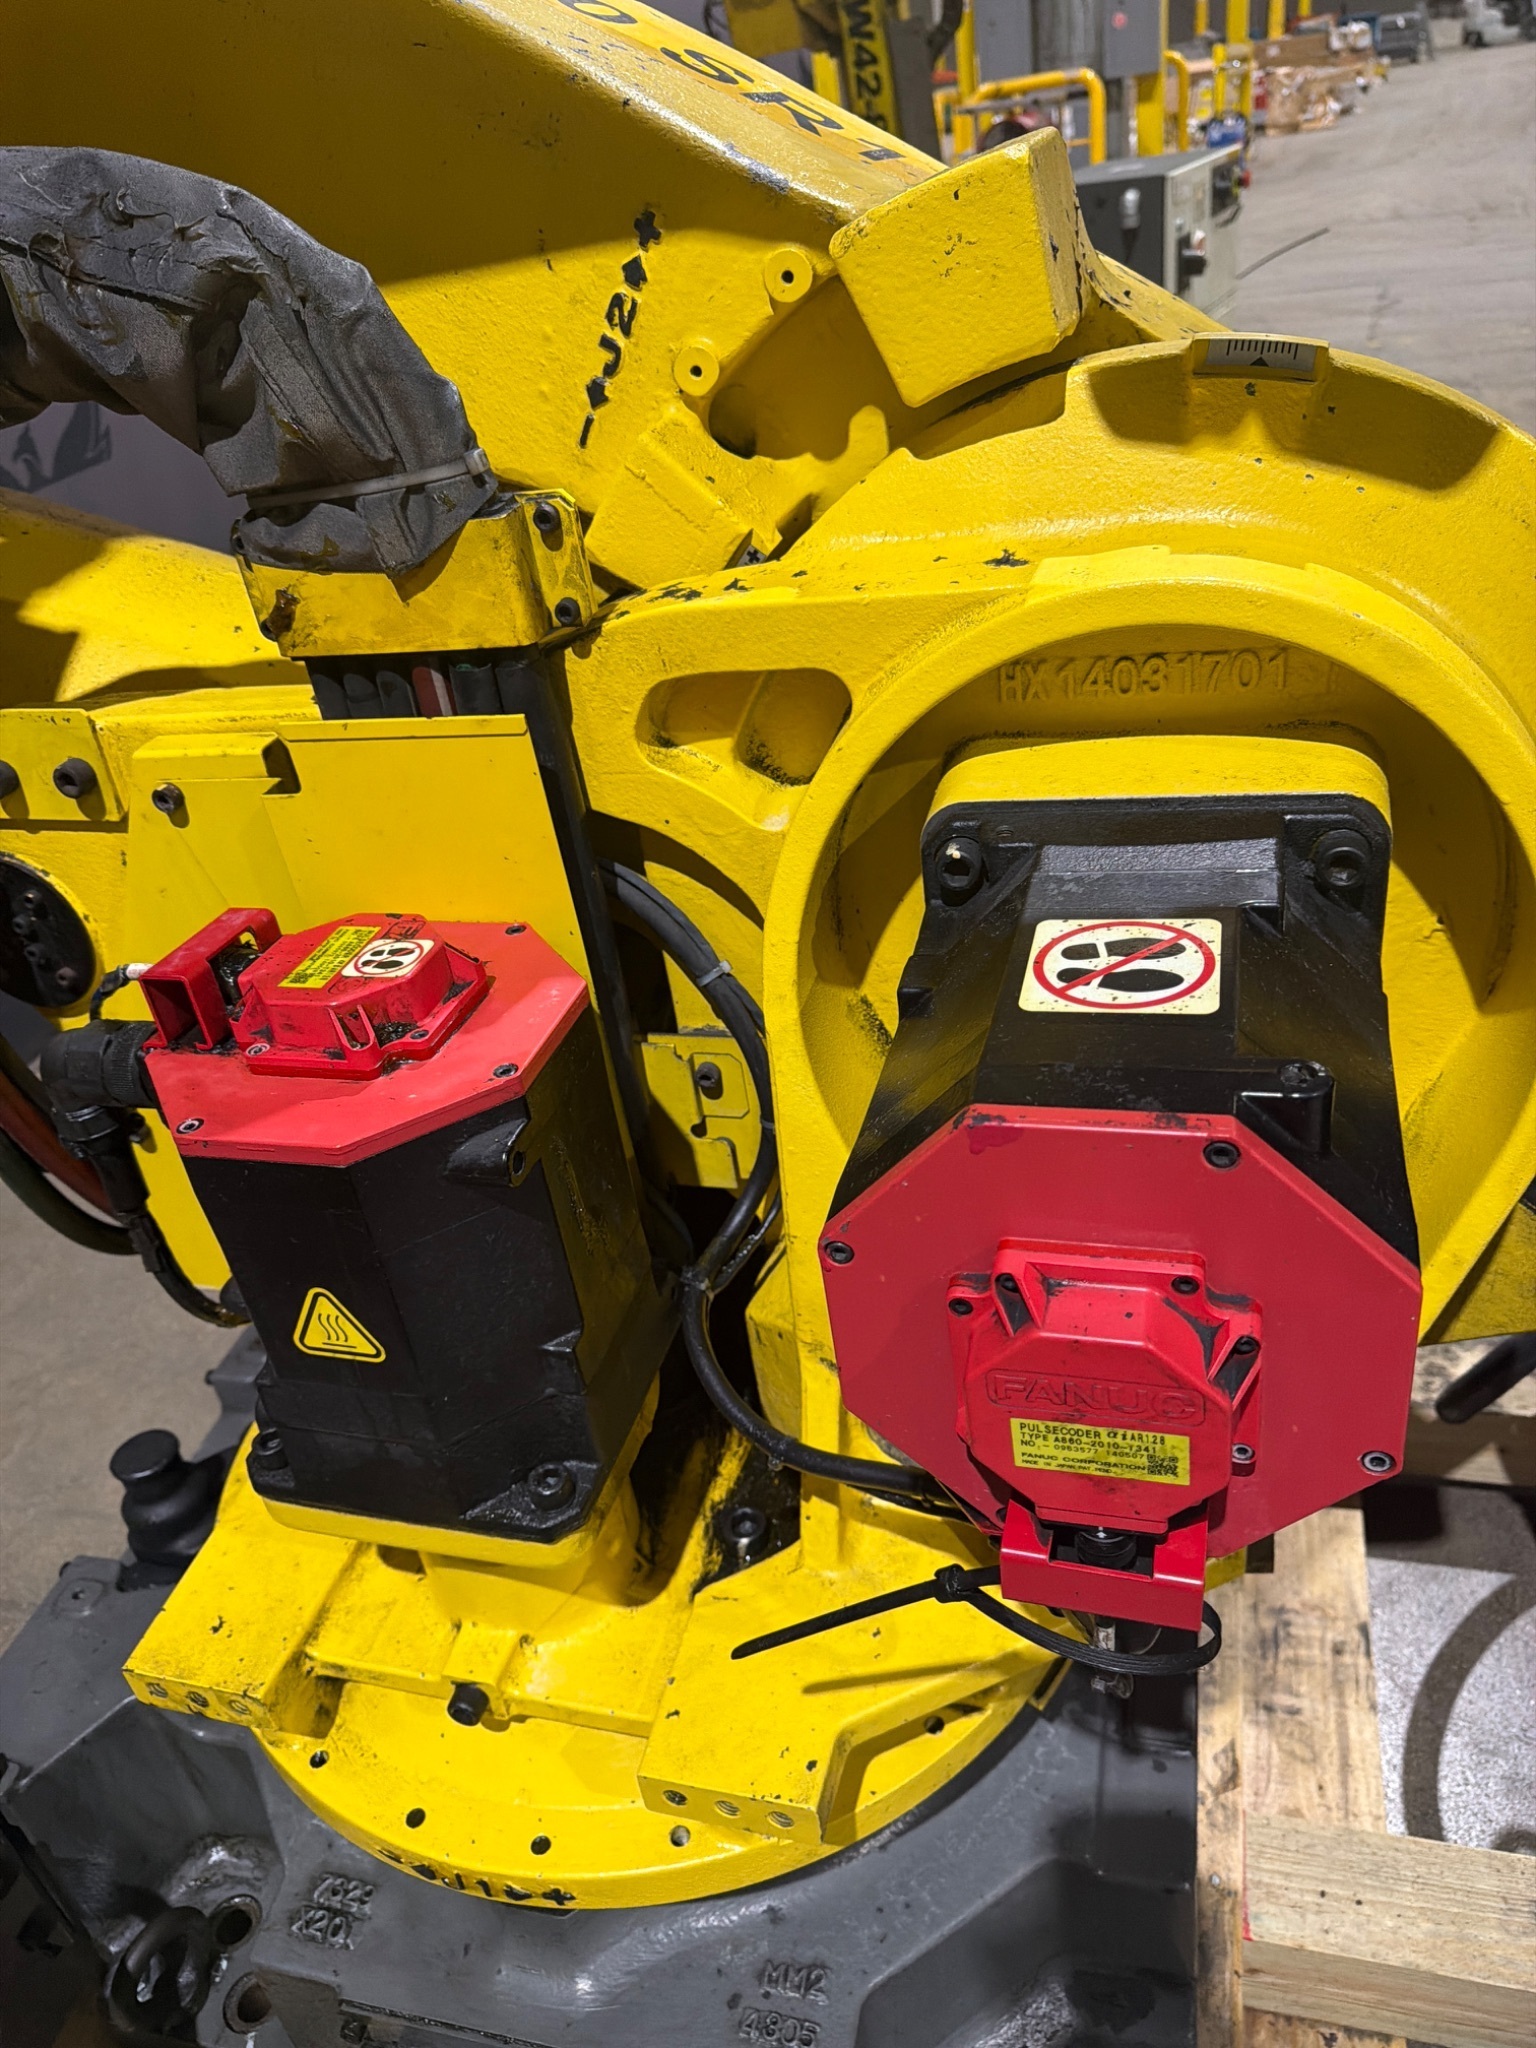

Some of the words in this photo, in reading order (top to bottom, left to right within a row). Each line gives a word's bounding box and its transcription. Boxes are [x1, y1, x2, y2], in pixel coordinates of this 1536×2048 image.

[598, 292, 638, 379] J2
[994, 1374, 1196, 1420] FANUC
[1020, 1422, 1101, 1439] PULSECODER
[1021, 1432, 1049, 1441] TYPE
[1021, 1452, 1058, 1461] FANUC
[1063, 1456, 1146, 1471] CORPORATION
[1106, 1450, 1144, 1459] 140507
[763, 1961, 829, 2005] MM2
